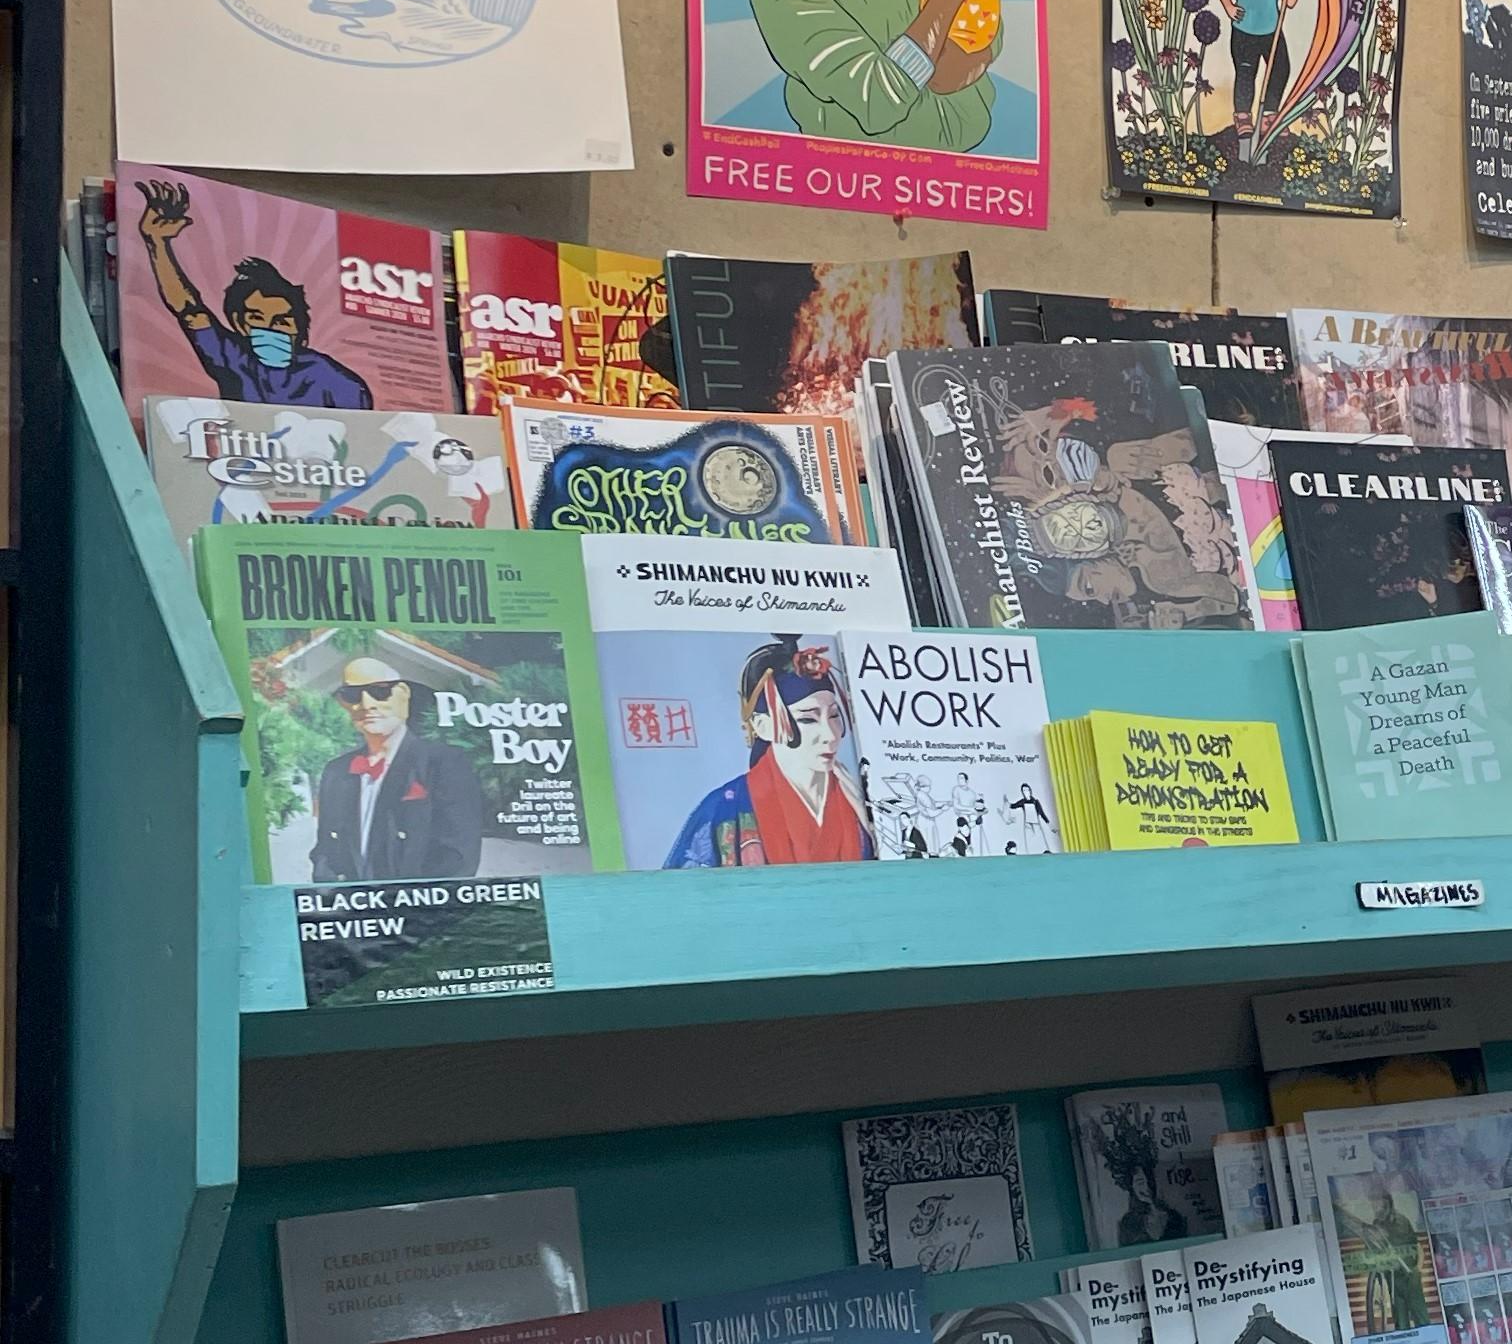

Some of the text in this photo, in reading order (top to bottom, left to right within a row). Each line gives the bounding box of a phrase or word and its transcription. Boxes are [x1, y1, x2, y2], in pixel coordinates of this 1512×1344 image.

[705, 156, 1035, 218] FREE OUR SISTERS!
[340, 255, 432, 304] asr
[471, 292, 563, 338] asr
[239, 553, 379, 621] BROKEN
[384, 557, 496, 625] PENCIL
[497, 569, 522, 583] 101
[636, 562, 853, 589] SHIMANCHU NU KWII
[858, 644, 1033, 684] ABOLISH
[1371, 658, 1448, 682] A Gazan
[1360, 680, 1466, 709] Young Man
[435, 691, 567, 728] Poster
[862, 690, 1000, 729] WORK
[1369, 706, 1466, 732] Dreams of
[491, 728, 571, 773] Boy
[1373, 729, 1471, 753] a Peaceful
[1400, 755, 1455, 777] Death
[525, 779, 571, 789] Twitter
[1116, 784, 1268, 813] DEMONSTRATION
[497, 812, 576, 823] future of art
[543, 833, 580, 844] online
[298, 883, 540, 913] BLACK AND GREEN
[1376, 883, 1479, 906] MAGAZINES
[300, 916, 404, 942] REVIEW
[437, 963, 552, 981] WILD EXISTENCE
[377, 977, 554, 1001] PASSIONATE RESISTANCE
[1194, 1261, 1226, 1277] De-
[1197, 1257, 1304, 1290] mystifying
[1197, 1276, 1316, 1308] The Japanese House
[766, 1312, 780, 1340] IS
[785, 1302, 839, 1336] REALLY
[846, 1288, 920, 1333] STRANGE
